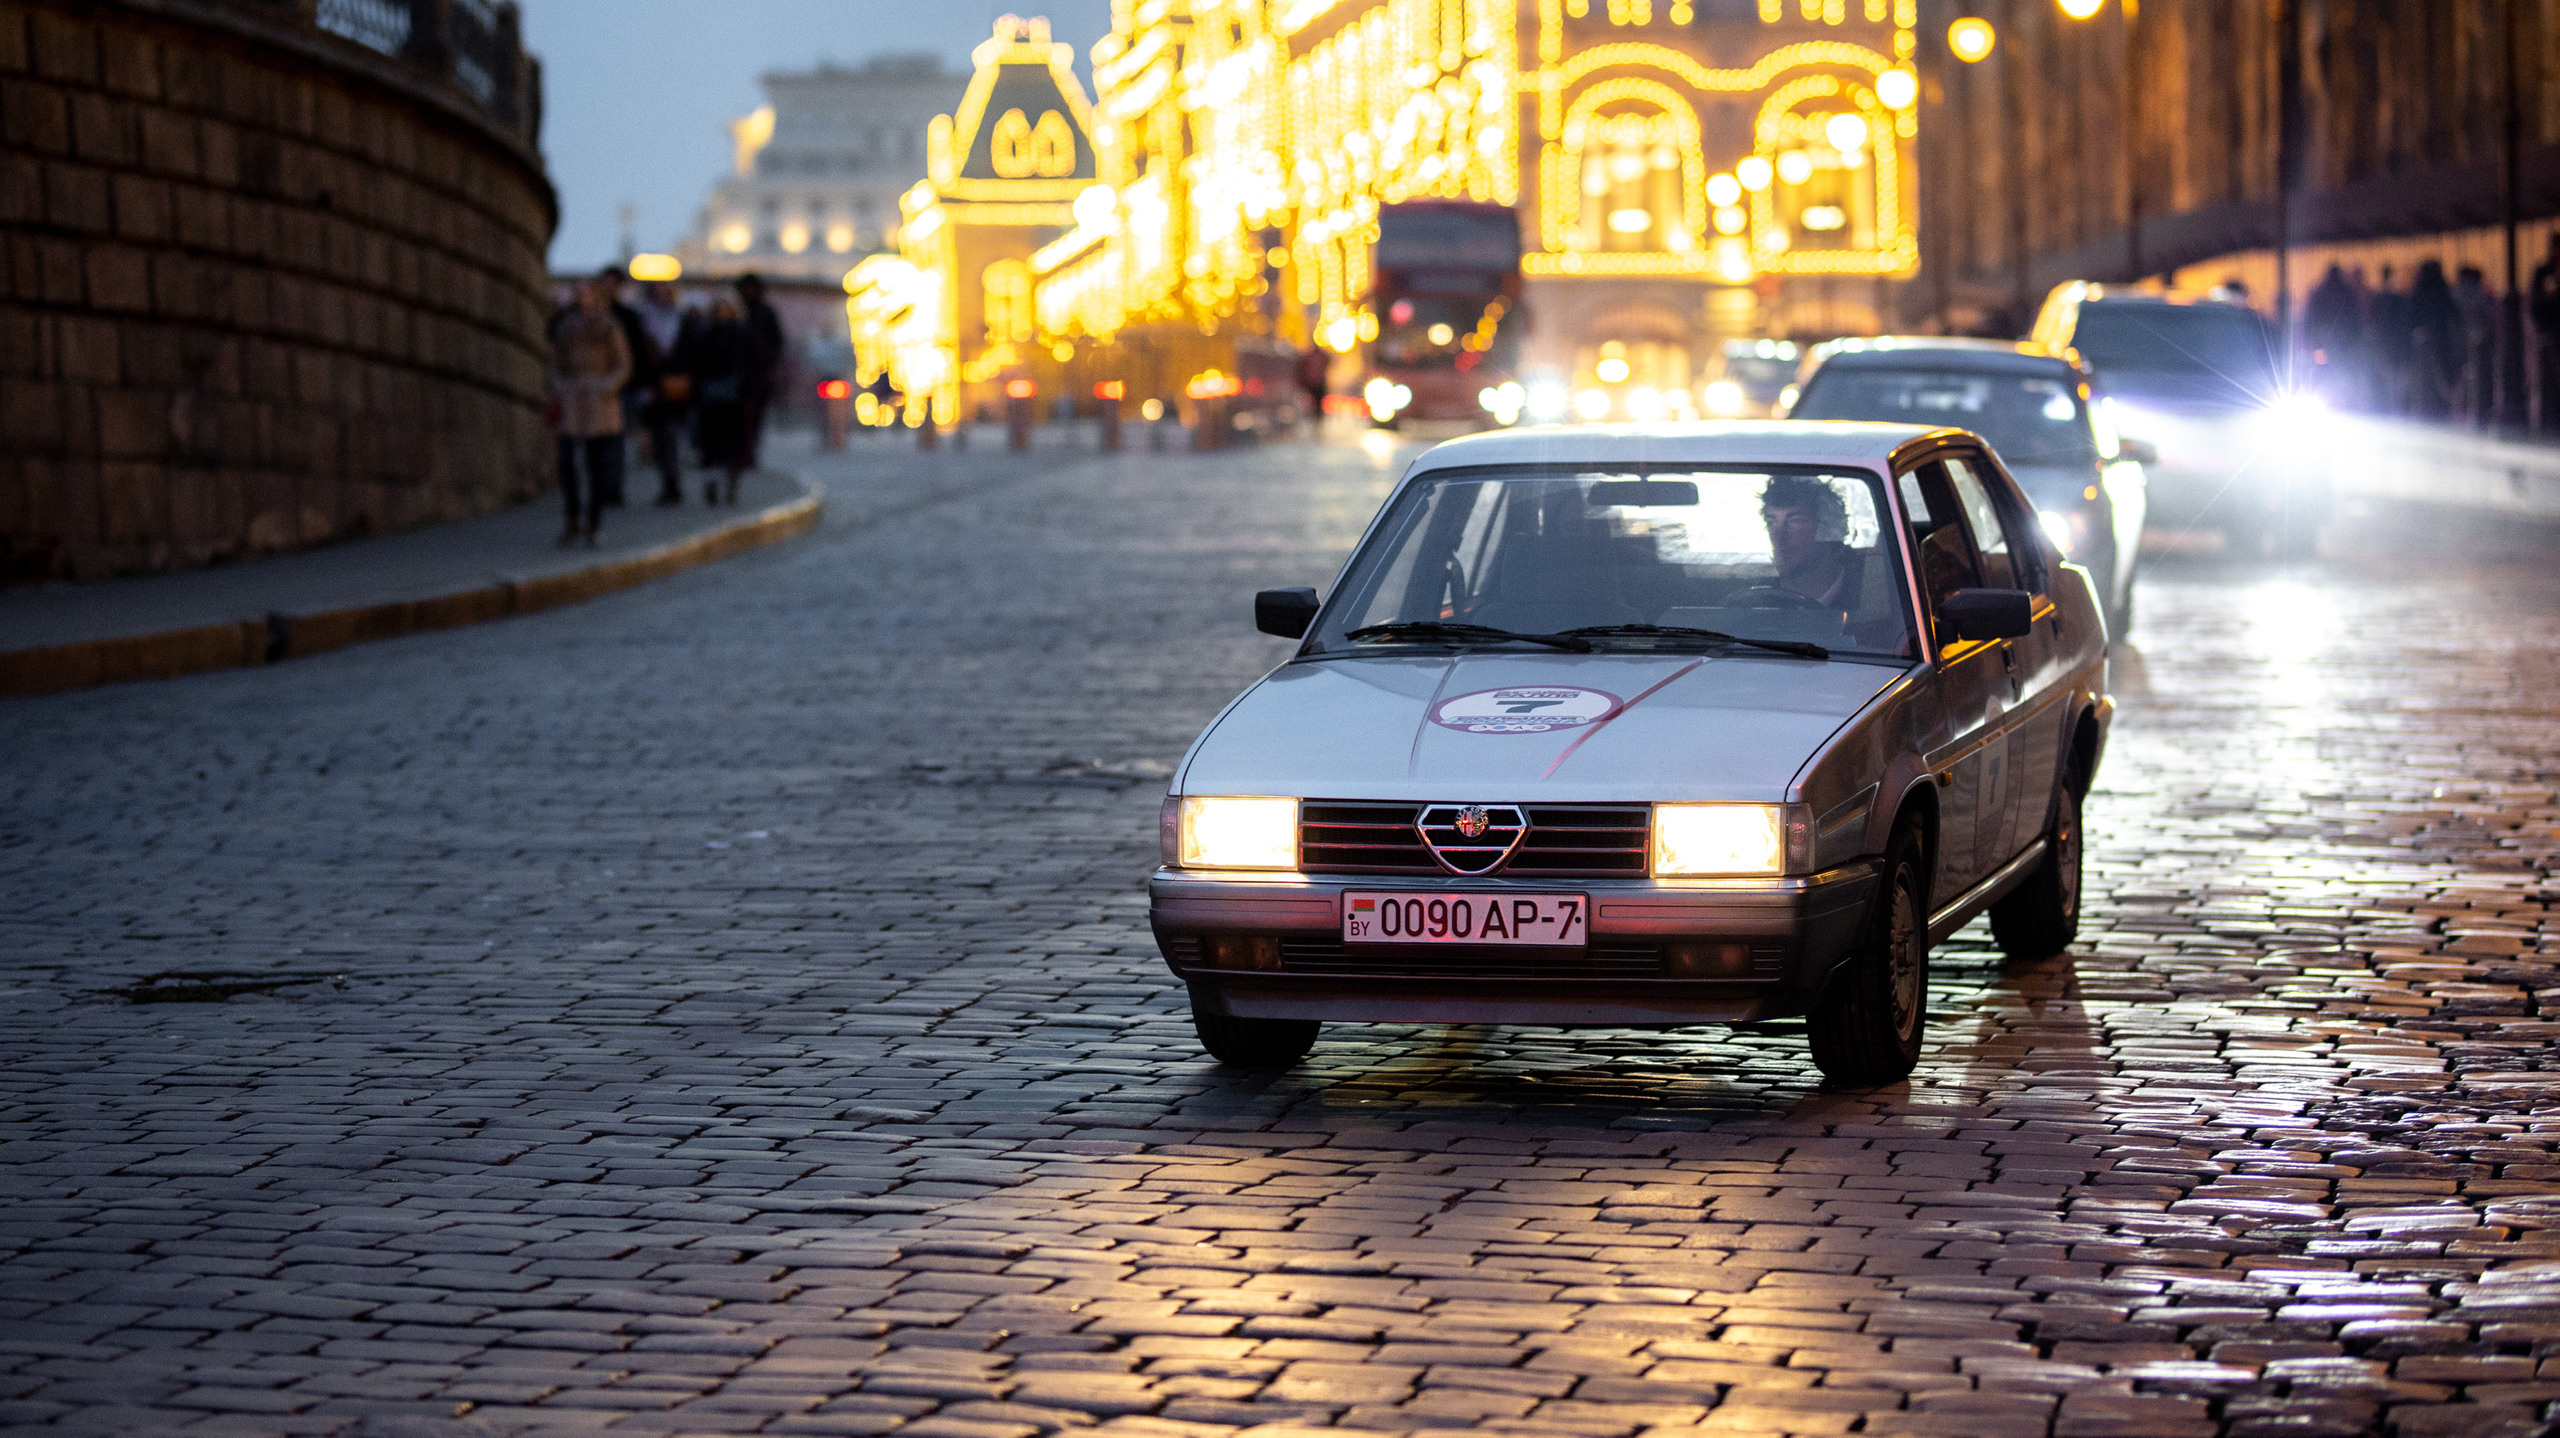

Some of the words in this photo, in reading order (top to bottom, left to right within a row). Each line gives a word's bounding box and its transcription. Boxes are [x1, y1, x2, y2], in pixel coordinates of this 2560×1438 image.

[1496, 701, 1564, 713] 7
[1381, 898, 1472, 938] 0090
[1480, 899, 1579, 939] AP-7
[1350, 921, 1370, 936] BY
